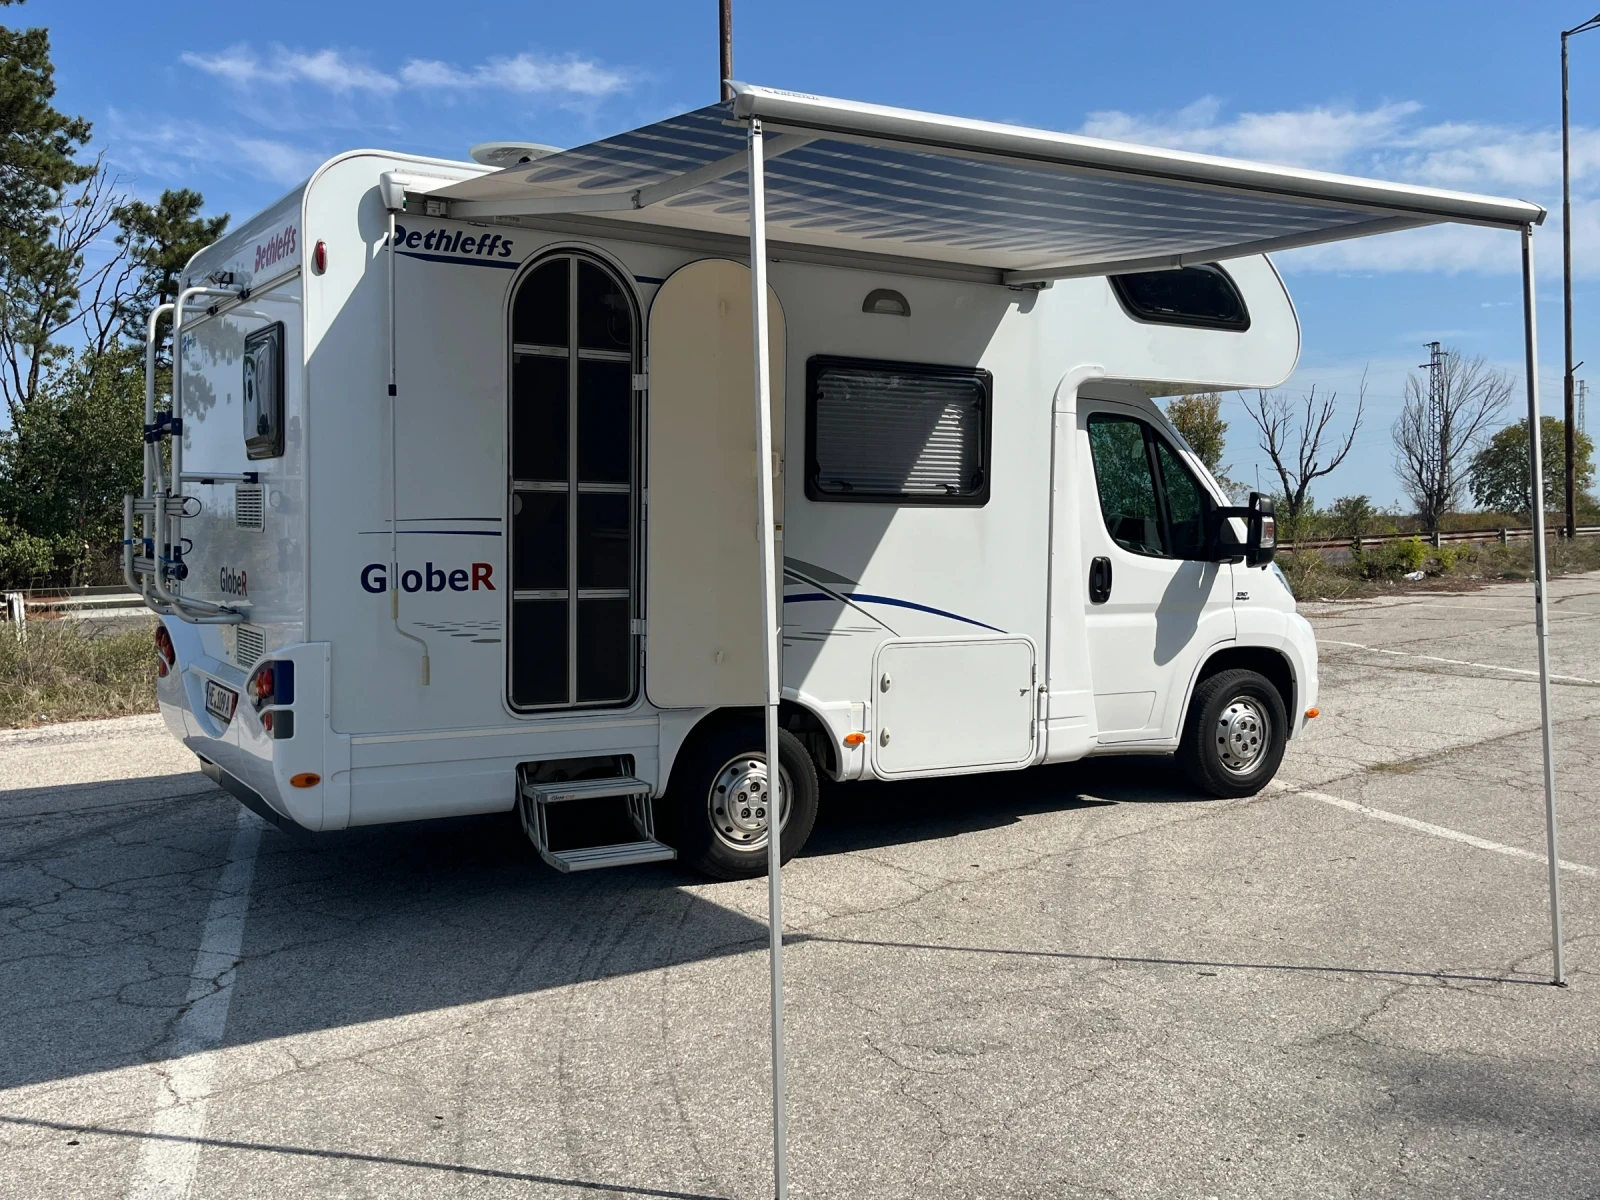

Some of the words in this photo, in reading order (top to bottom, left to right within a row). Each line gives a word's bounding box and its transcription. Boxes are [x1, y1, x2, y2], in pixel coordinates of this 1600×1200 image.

[254, 225, 297, 273] Dethleffs
[385, 224, 514, 257] Dethleffs
[220, 566, 248, 597] GlobeR
